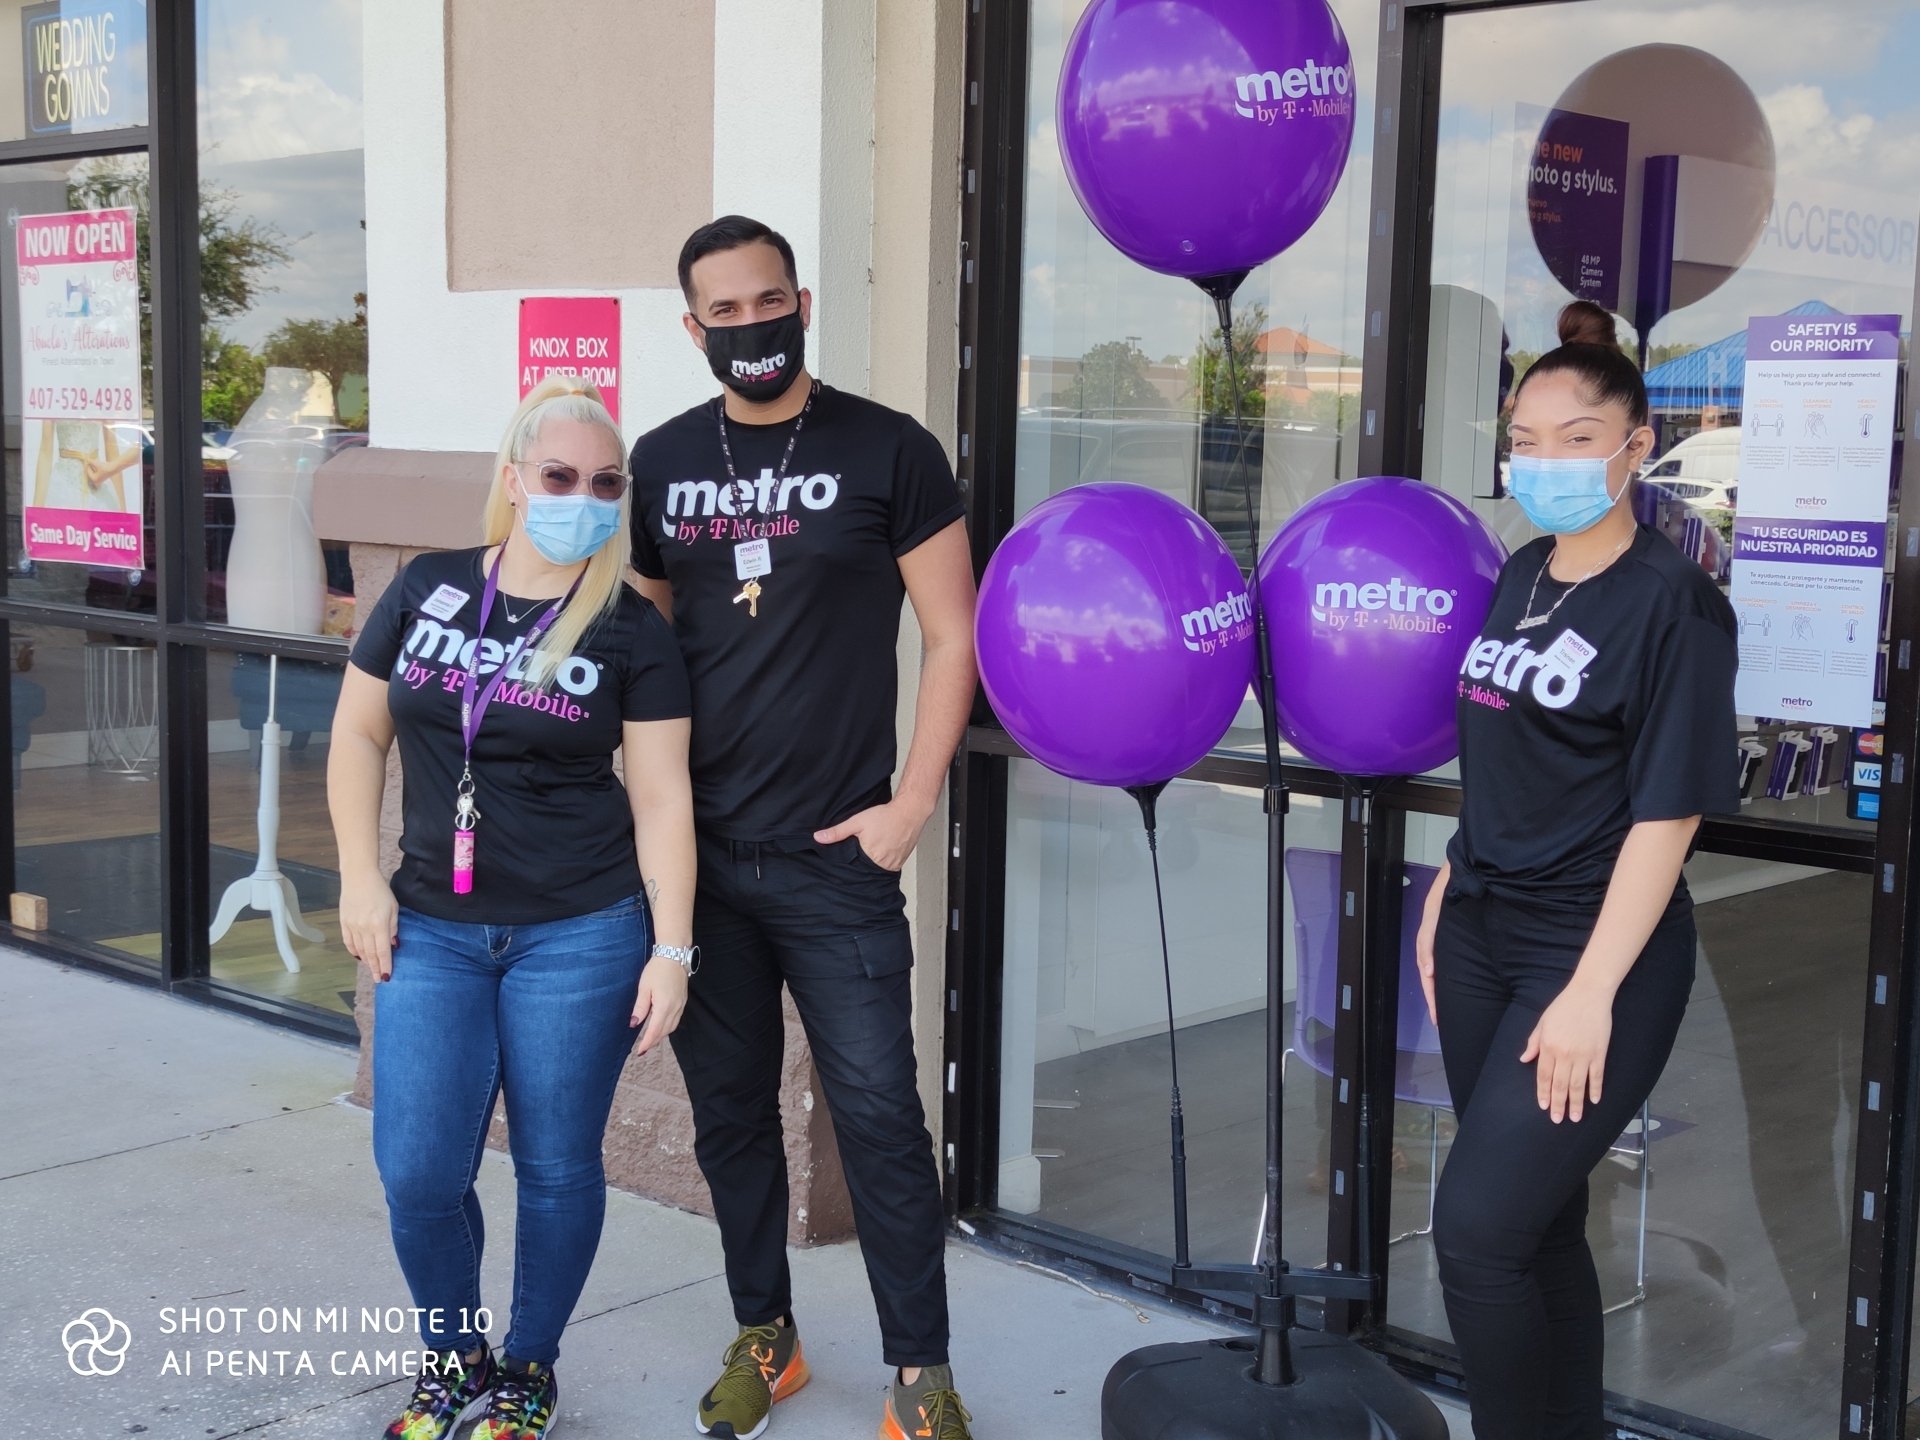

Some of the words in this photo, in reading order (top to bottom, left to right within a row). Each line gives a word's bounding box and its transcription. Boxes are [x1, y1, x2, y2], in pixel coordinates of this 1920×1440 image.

[36, 12, 116, 74] WEDDING
[1235, 59, 1348, 104] metro
[45, 65, 110, 123] GOWNS
[1256, 105, 1278, 126] by
[1553, 144, 1583, 162] new
[1562, 171, 1571, 192] g
[1574, 169, 1617, 196] stylus.
[26, 226, 70, 258] NOW
[74, 221, 126, 255] OPEN
[1762, 197, 1916, 265] ACCESSOR
[1581, 265, 1603, 277] Camera
[1590, 255, 1601, 265] MP
[1580, 276, 1602, 288] System
[1787, 323, 1841, 337] SAFETY
[1844, 323, 1857, 336] IS
[530, 337, 569, 358] KNOX
[576, 337, 608, 358] BOX
[1770, 339, 1803, 353] OUR
[1805, 338, 1874, 353] PRIORITY
[732, 353, 786, 376] metro
[522, 366, 541, 387] AT
[581, 366, 616, 388] ROOM
[29, 387, 133, 411] 407-529-4928
[666, 468, 838, 517] metro
[1795, 496, 1827, 507] metro
[31, 522, 64, 545] Same
[65, 525, 91, 552] Day
[93, 527, 137, 550] Service
[678, 521, 704, 546] by
[1752, 526, 1770, 539] TU
[1771, 527, 1849, 542] SEGURIDAD
[1850, 530, 1868, 543] ES
[1740, 540, 1801, 554] NUESTRA
[1803, 542, 1878, 558] PRIORIDAD
[1315, 577, 1454, 616] metro
[1181, 590, 1252, 638] metro
[1329, 611, 1350, 631] by
[406, 619, 599, 695] metro
[1200, 638, 1217, 657] by
[1566, 635, 1590, 657] metro
[404, 660, 437, 690] by
[1460, 635, 1581, 709] etro
[1781, 696, 1813, 707] metro
[462, 702, 471, 727] metro
[1858, 768, 1881, 781] VIS
